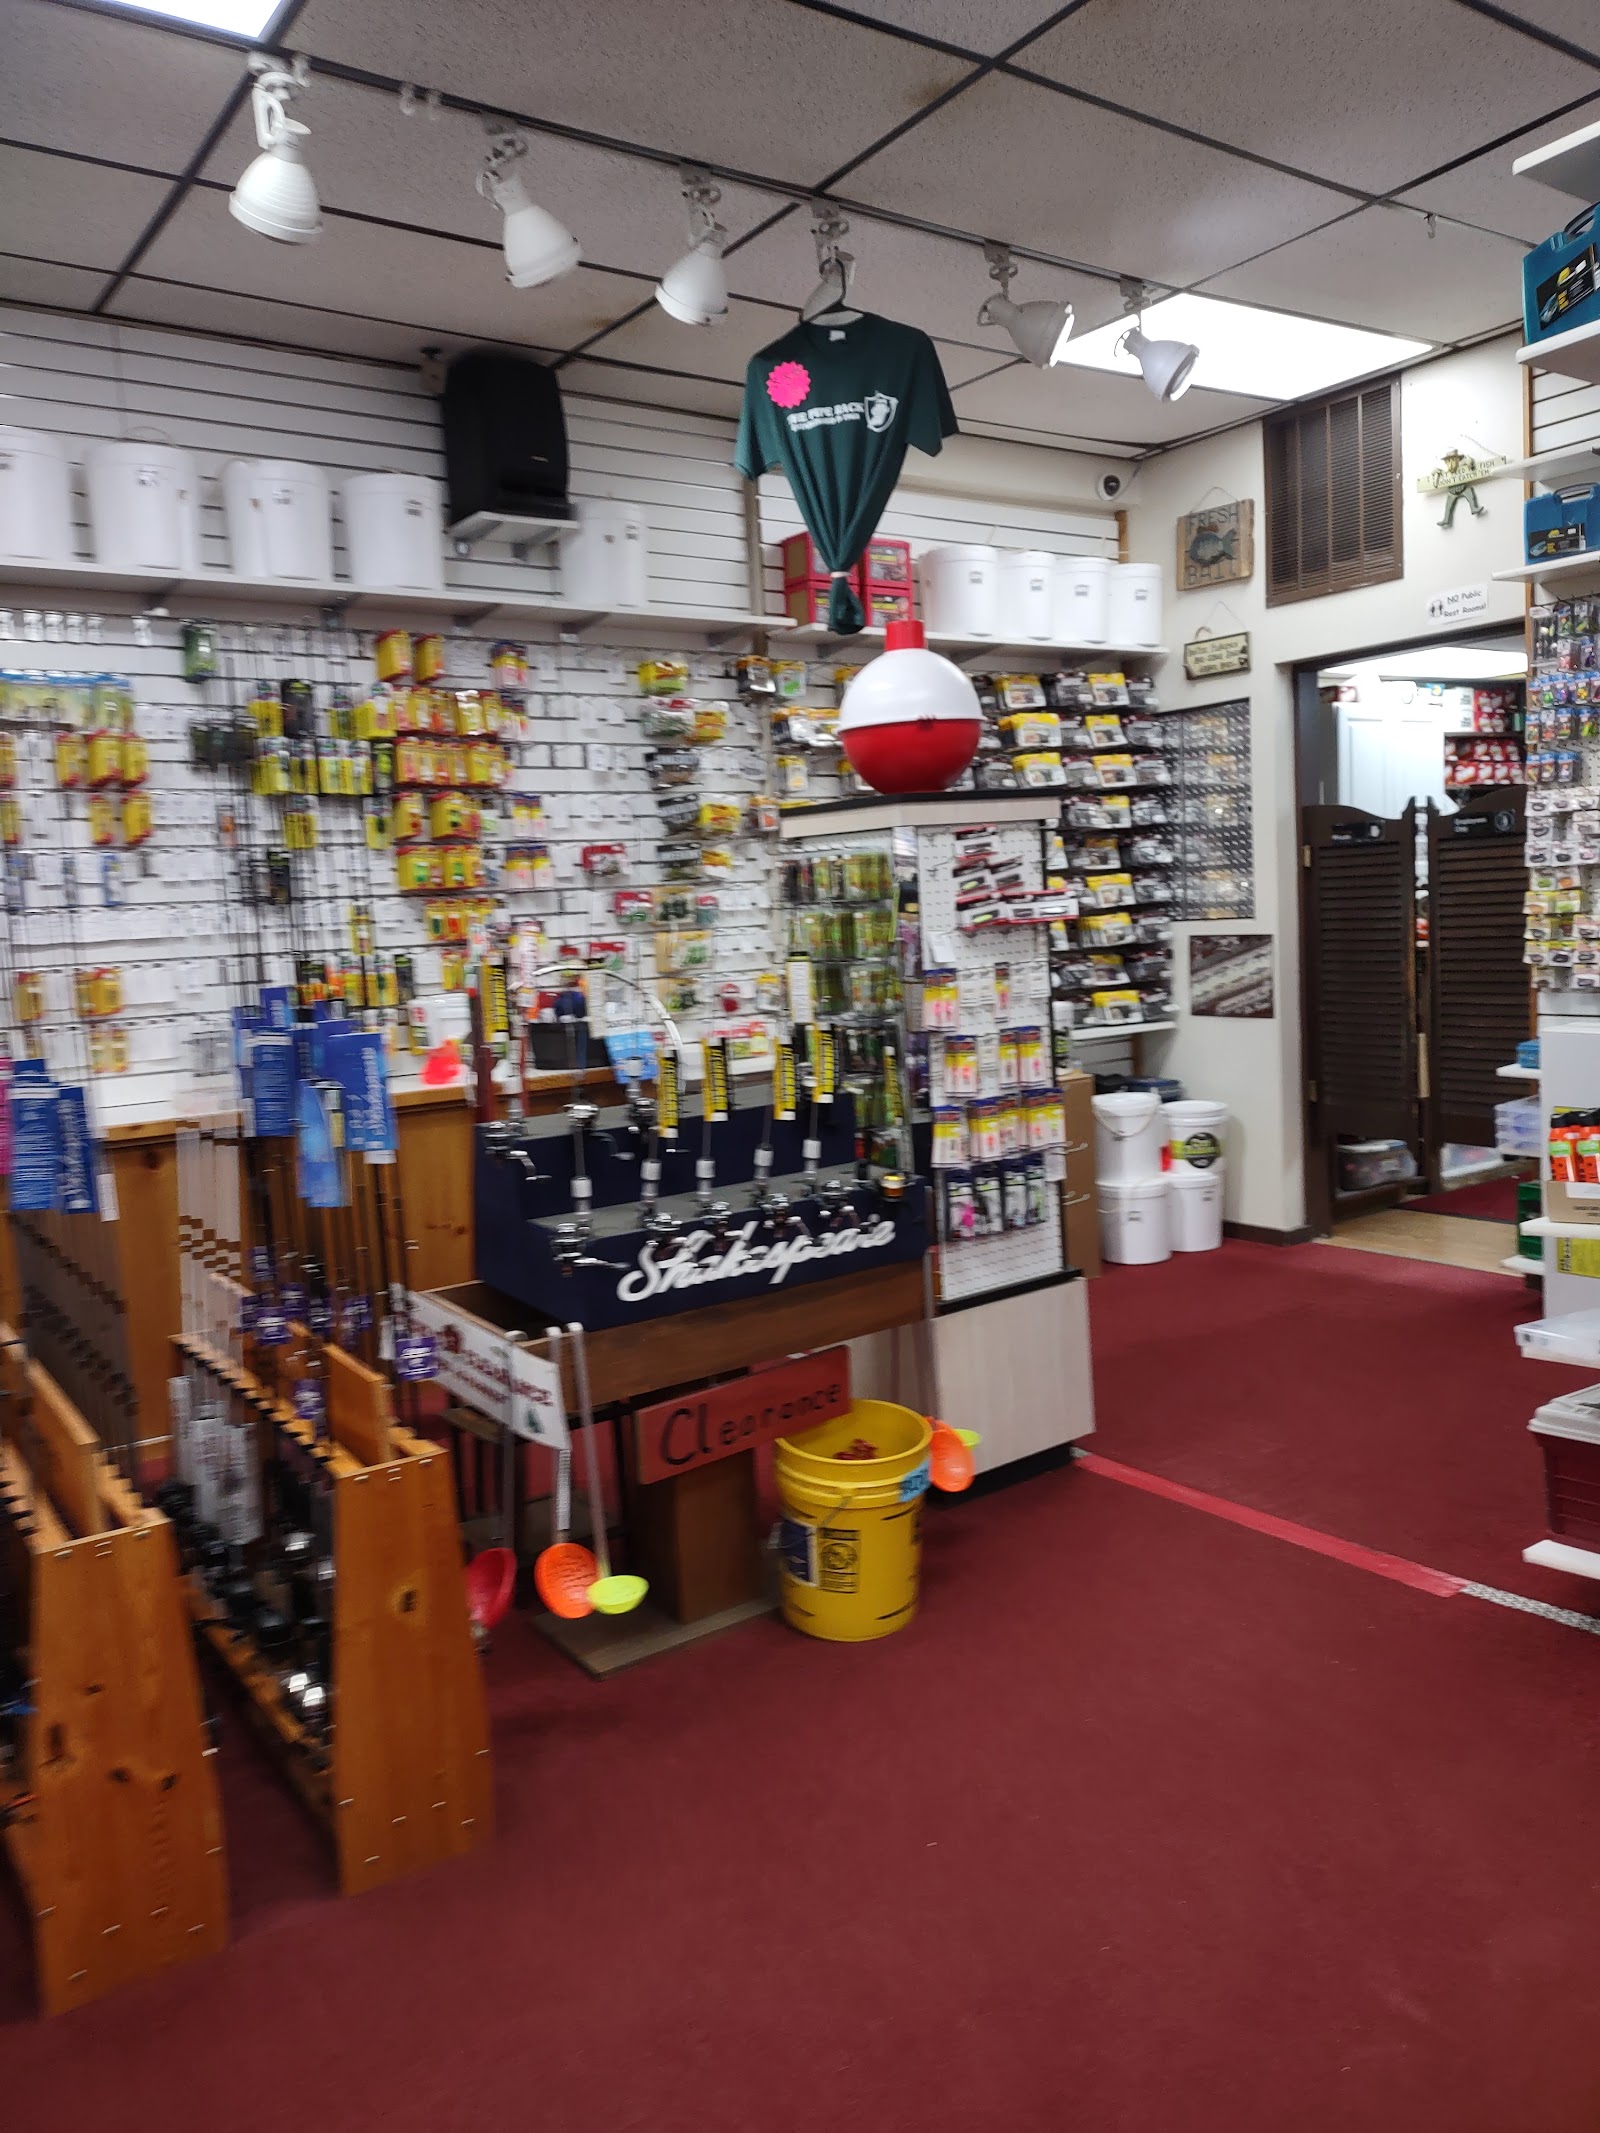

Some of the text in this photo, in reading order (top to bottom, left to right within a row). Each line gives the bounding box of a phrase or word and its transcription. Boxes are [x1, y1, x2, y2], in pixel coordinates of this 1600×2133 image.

[1186, 502, 1239, 533] FRESH
[617, 1220, 896, 1302] Shakespeare
[661, 1383, 840, 1465] Clearance
